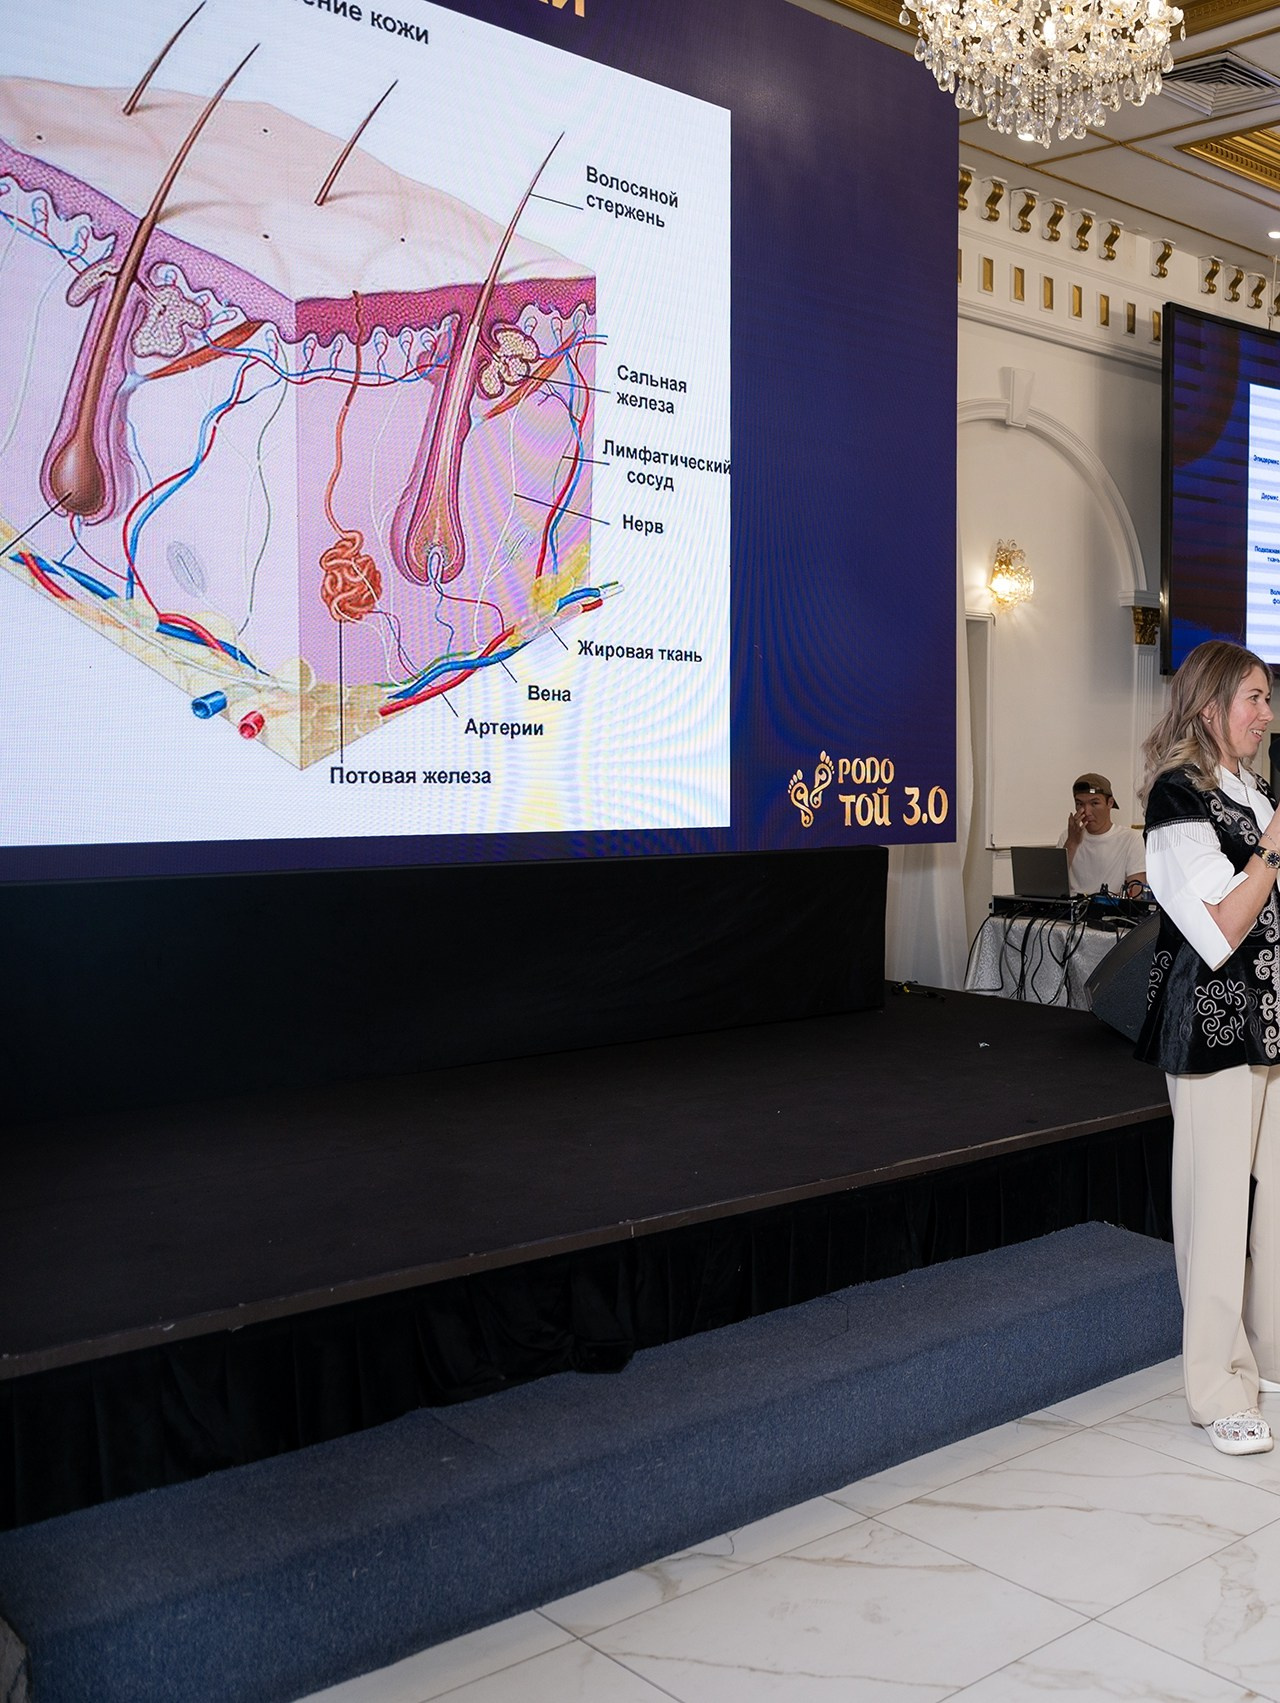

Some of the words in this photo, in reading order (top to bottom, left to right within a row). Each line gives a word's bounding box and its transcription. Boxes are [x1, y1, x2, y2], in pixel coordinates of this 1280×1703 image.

[371, 10, 429, 45] кожи
[586, 165, 679, 208] Волосяной
[586, 194, 665, 228] стержень
[617, 364, 687, 393] Сальная
[616, 391, 675, 414] железа
[602, 439, 731, 475] Лимфатический
[626, 470, 675, 492] сосуд
[622, 514, 665, 536] Нерв
[577, 639, 655, 662] Жировая
[658, 647, 703, 663] ткань
[527, 685, 572, 703] Вена
[464, 718, 544, 738] Артерии
[330, 767, 417, 785] Потовая
[422, 768, 492, 784] железа
[838, 756, 895, 784] PODO
[902, 785, 949, 826] 3.0
